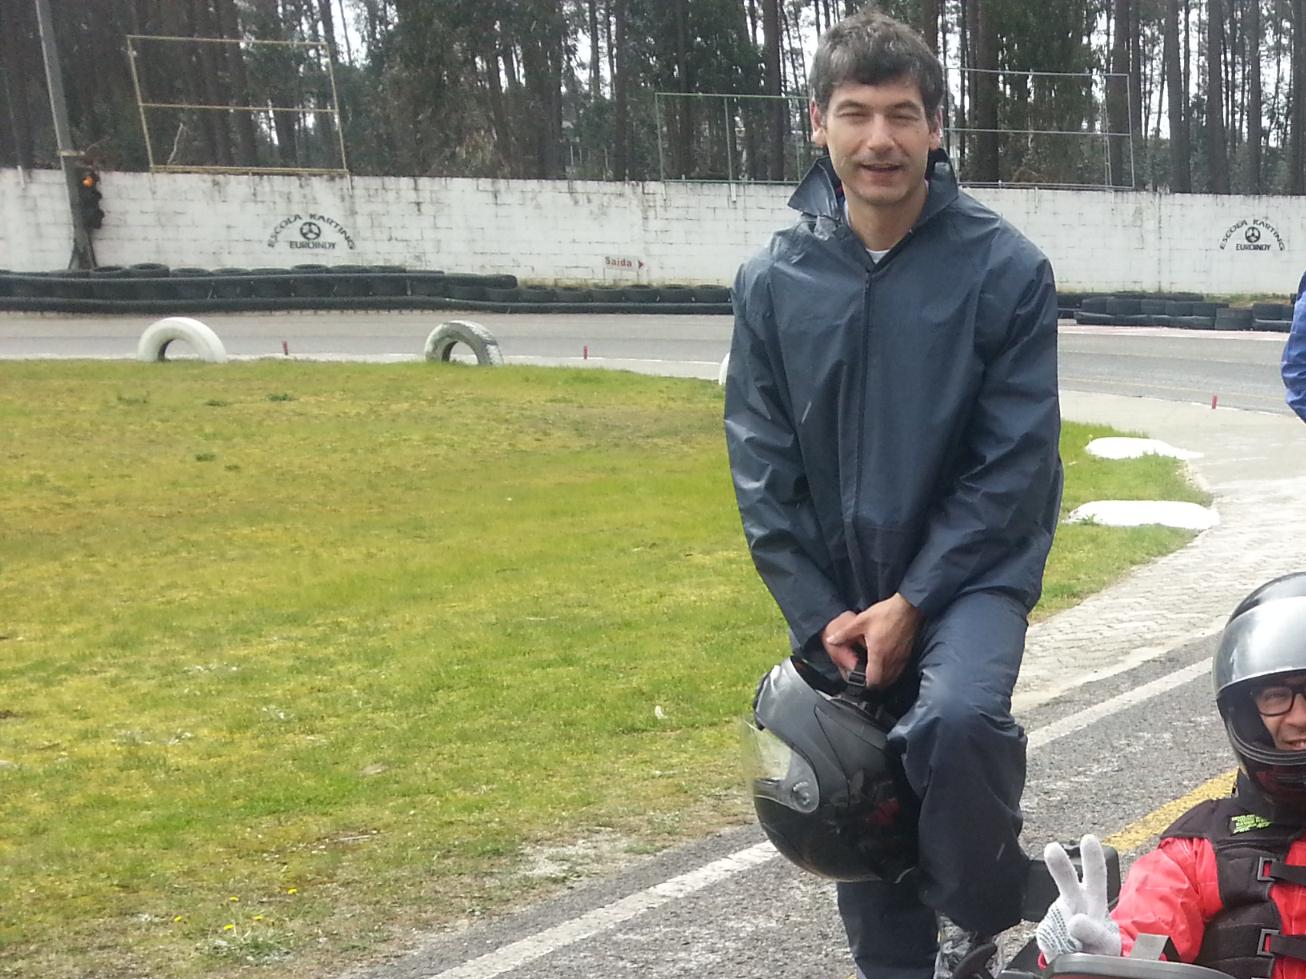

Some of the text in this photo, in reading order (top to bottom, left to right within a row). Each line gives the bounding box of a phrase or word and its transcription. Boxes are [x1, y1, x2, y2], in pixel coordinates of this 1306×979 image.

[267, 213, 355, 250] ESCOLA KARTING
[1219, 219, 1285, 251] ESCOLA KARTING
[289, 240, 336, 249] EUROINDY
[1235, 243, 1271, 251] EUROINDY
